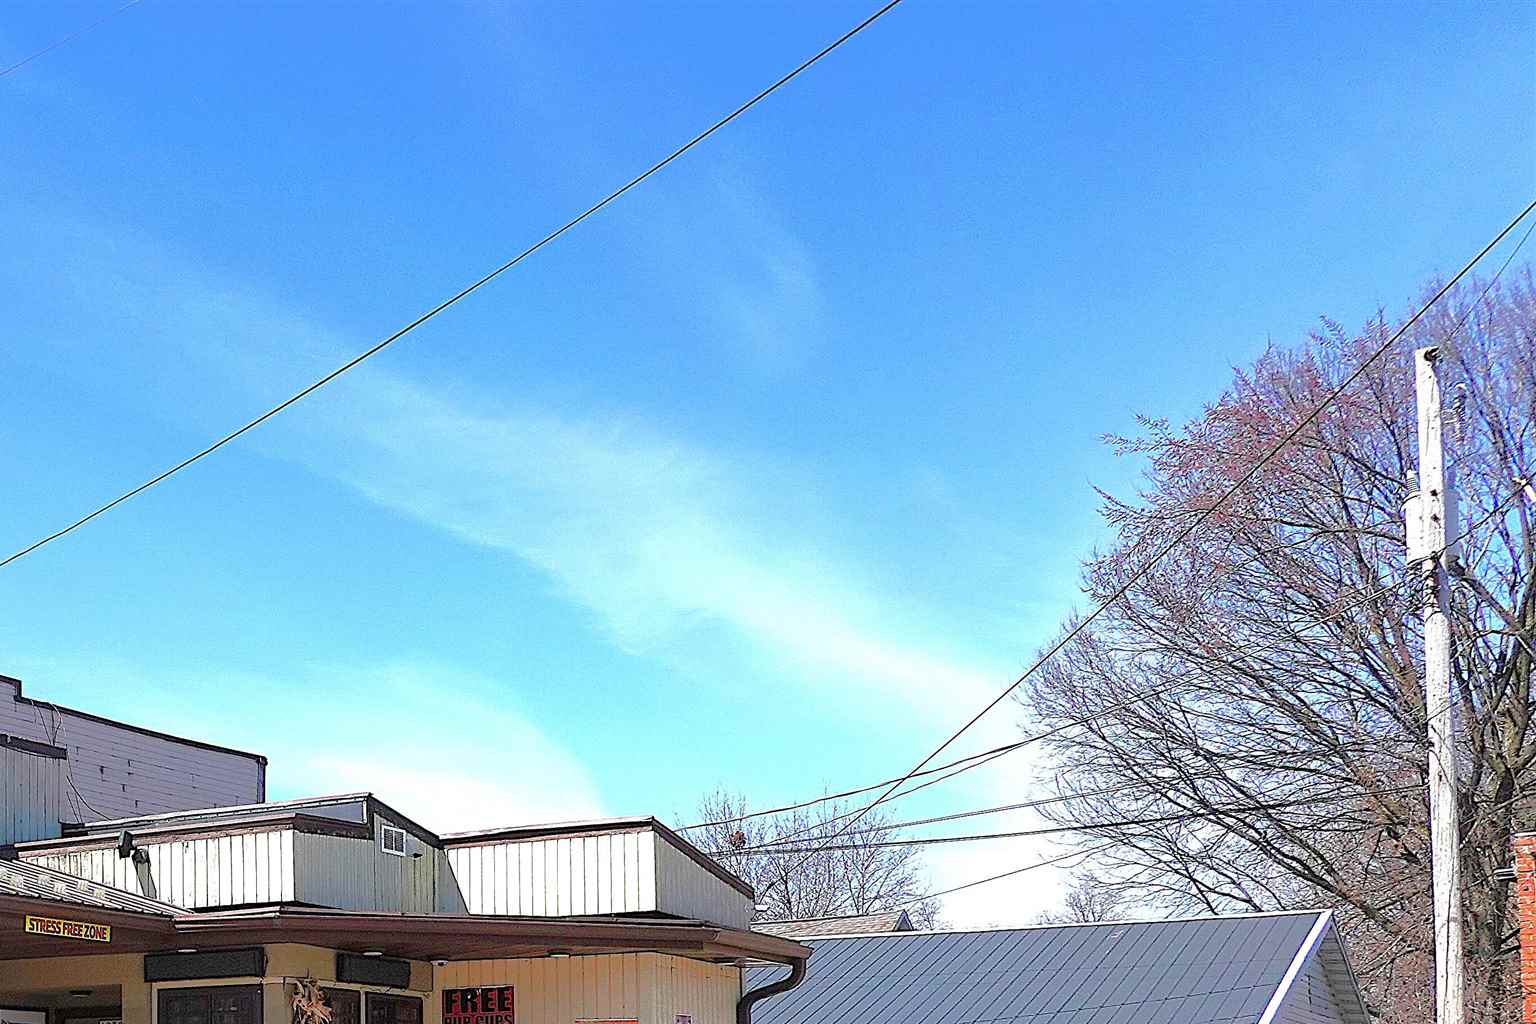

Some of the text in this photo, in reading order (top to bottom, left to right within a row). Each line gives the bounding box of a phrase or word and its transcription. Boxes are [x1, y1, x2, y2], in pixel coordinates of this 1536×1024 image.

[28, 917, 107, 940] STRESS FREE ZONE
[444, 986, 513, 1014] FREE
